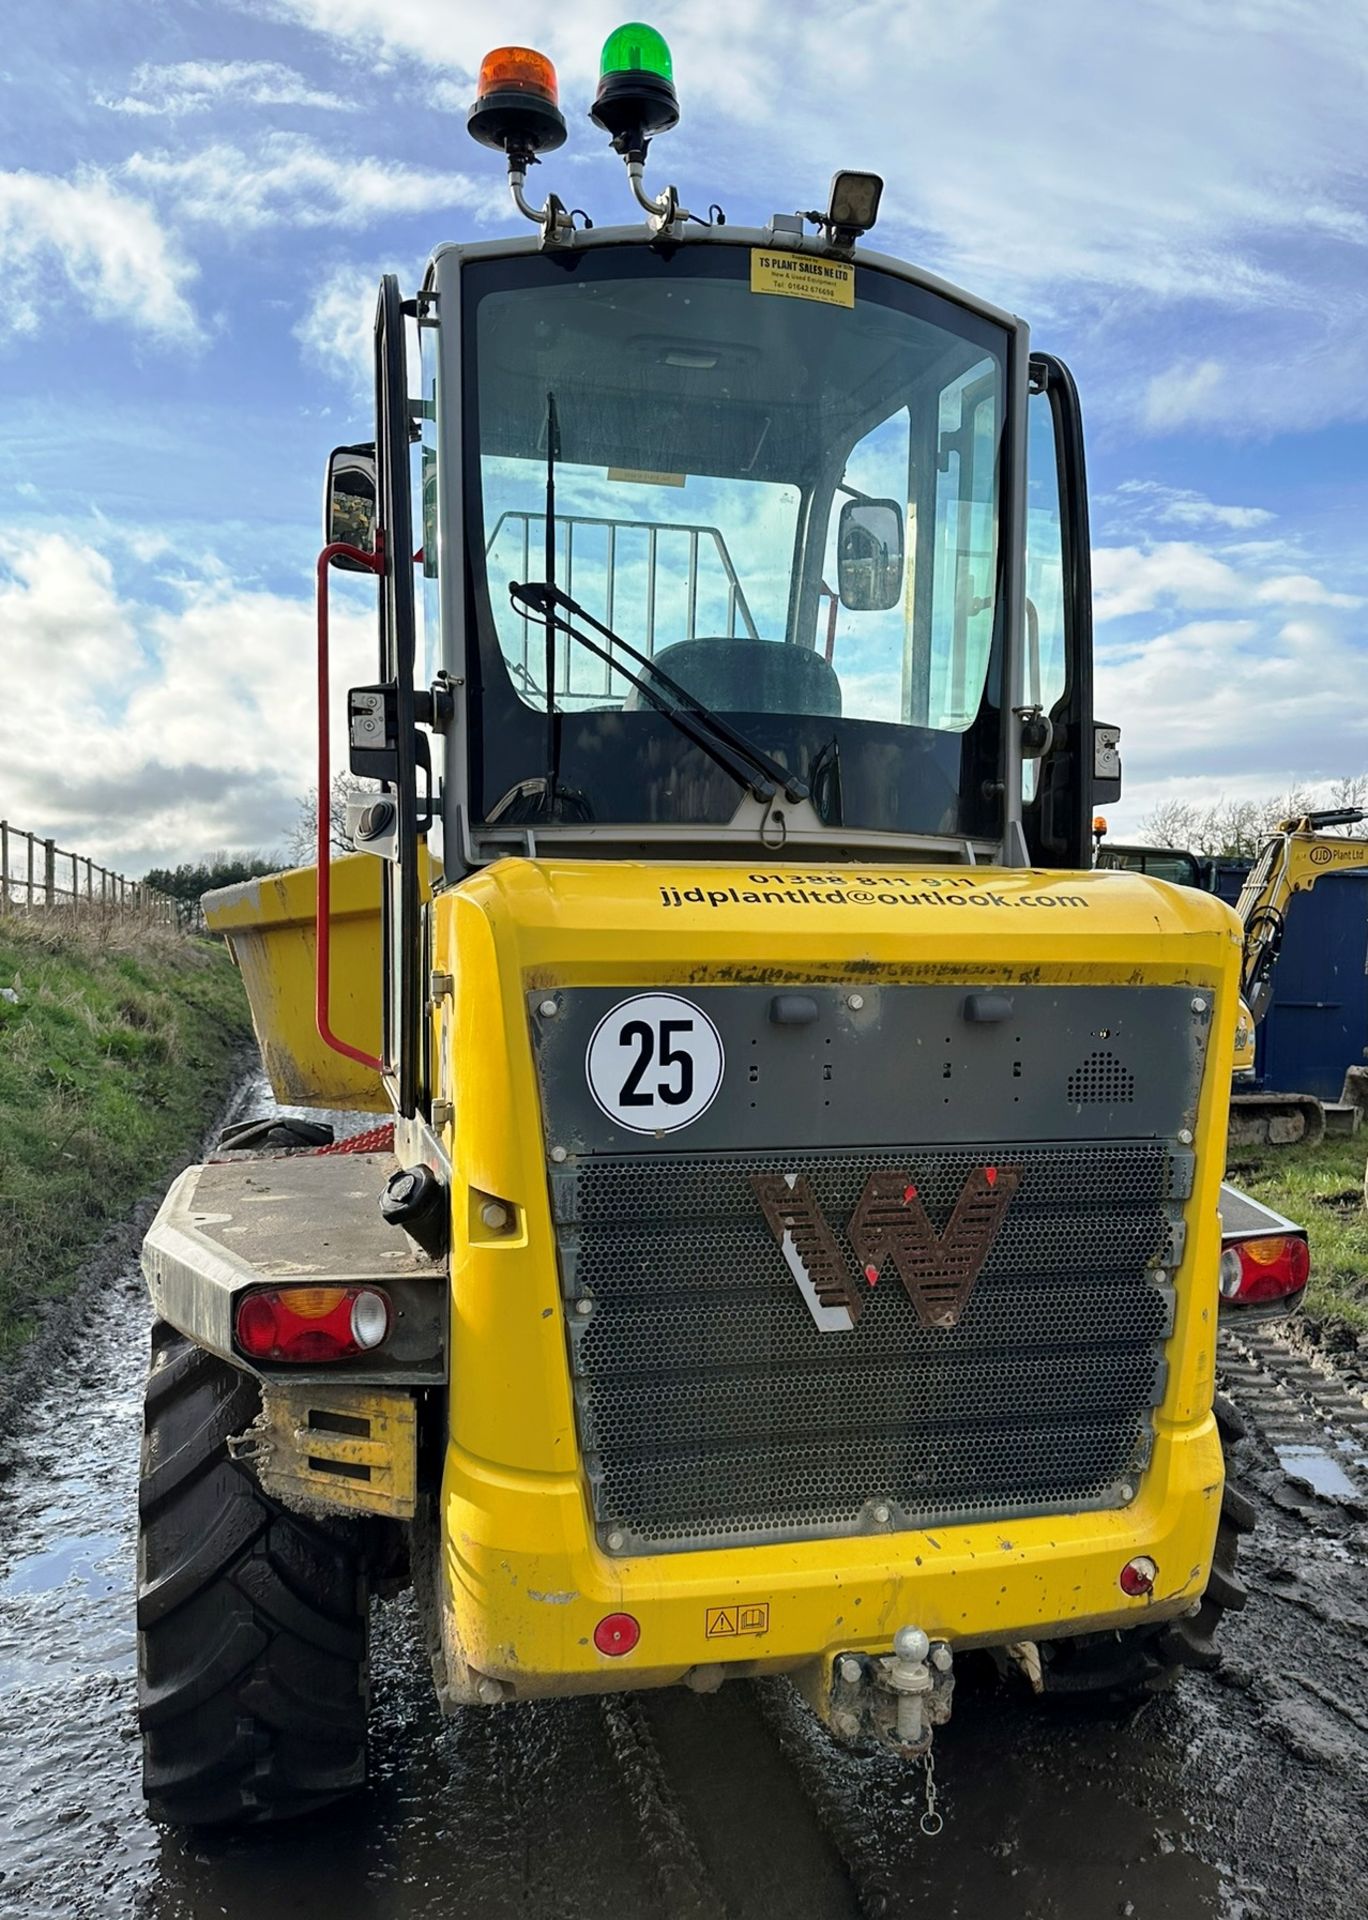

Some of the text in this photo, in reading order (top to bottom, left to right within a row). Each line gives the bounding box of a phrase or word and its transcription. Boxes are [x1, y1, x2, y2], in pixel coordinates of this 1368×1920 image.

[760, 257, 770, 268] TS
[772, 258, 797, 271] PLANT
[799, 262, 823, 276] SALES
[824, 267, 834, 278] NE
[835, 269, 848, 281] LTD
[791, 274, 806, 282] Used
[807, 276, 837, 287] Equipment
[1315, 849, 1365, 861] JJD Plant Ltd
[748, 874, 977, 888] 01388 811 911
[659, 887, 1090, 908] jjdplantltd@outlook.com
[619, 1020, 694, 1107] 25
